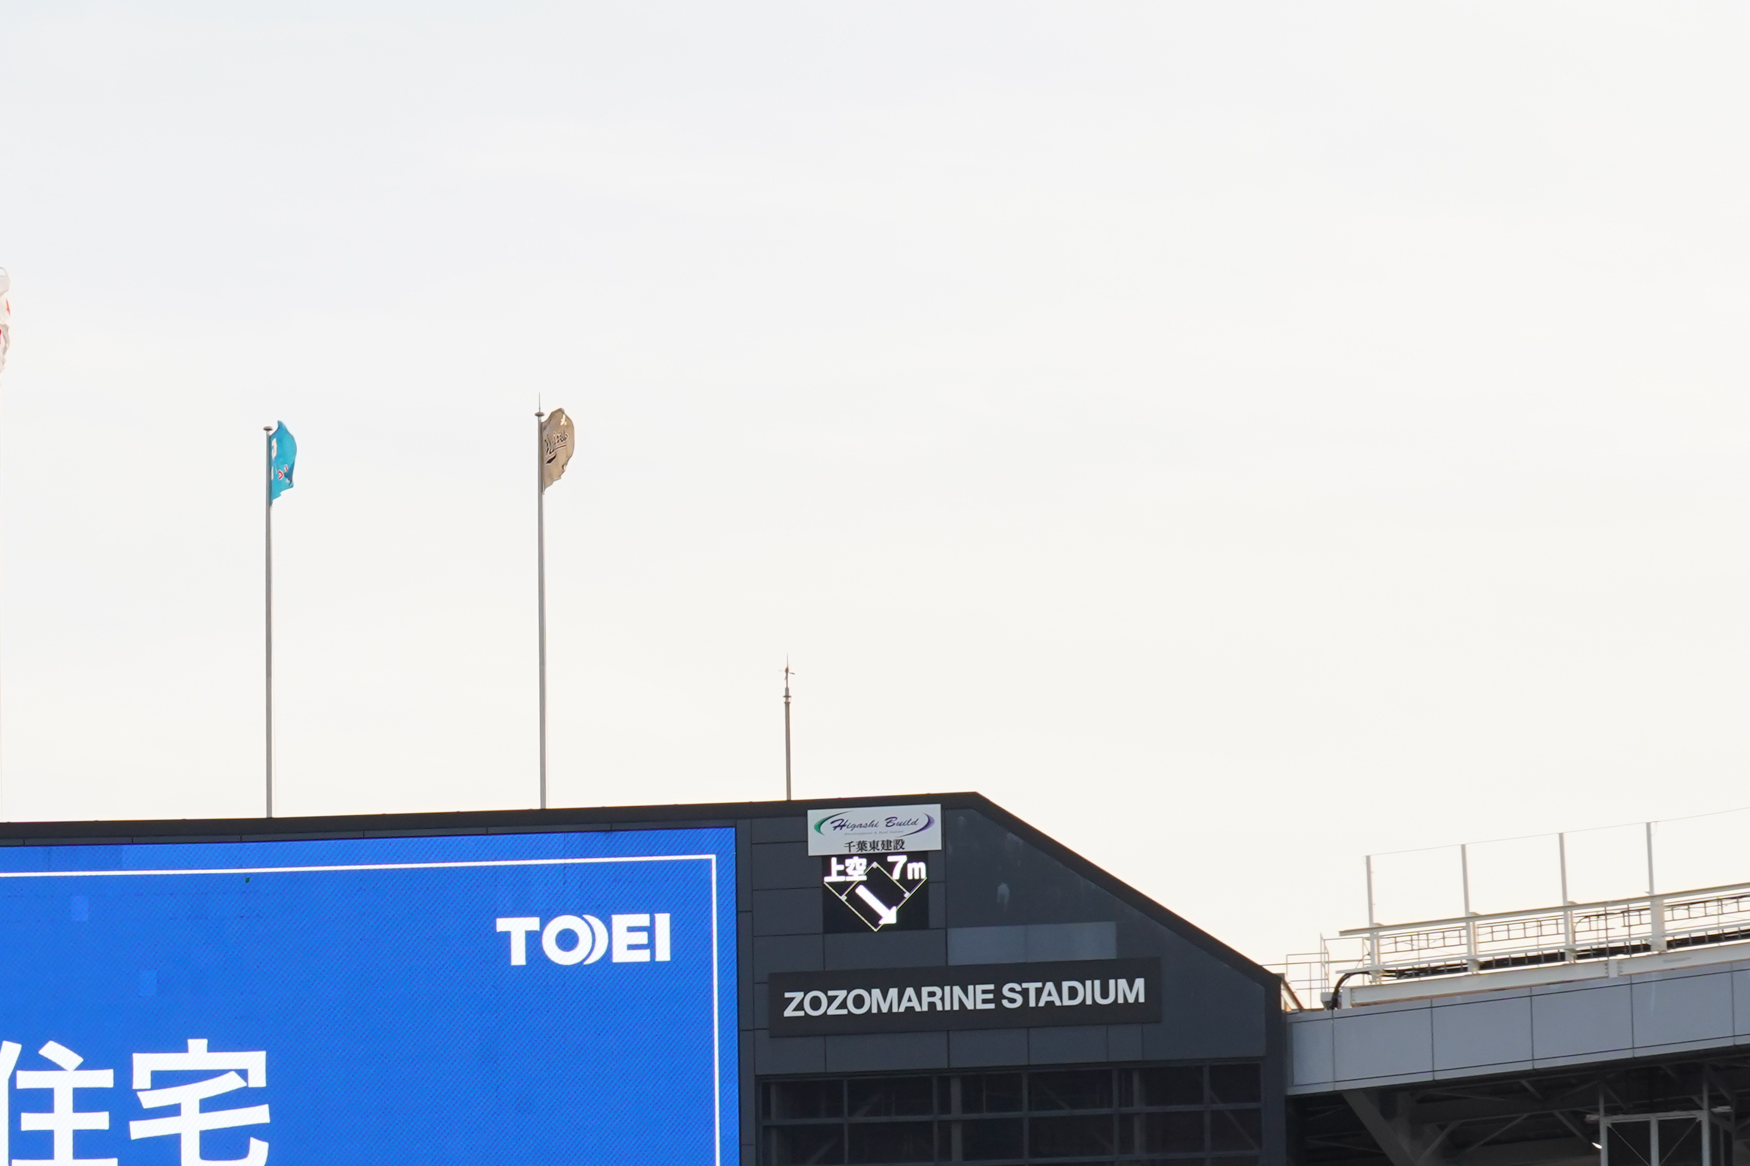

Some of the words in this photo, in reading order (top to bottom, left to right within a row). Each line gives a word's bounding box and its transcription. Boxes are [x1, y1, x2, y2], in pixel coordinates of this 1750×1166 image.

[830, 817, 879, 832] Higashi
[884, 816, 919, 828] Build
[844, 838, 905, 853] 千葉東建設
[823, 856, 868, 883] 上空
[887, 855, 927, 880] 7m
[782, 983, 995, 1017] ZOZOMARINE
[1001, 977, 1145, 1010] STADIUM
